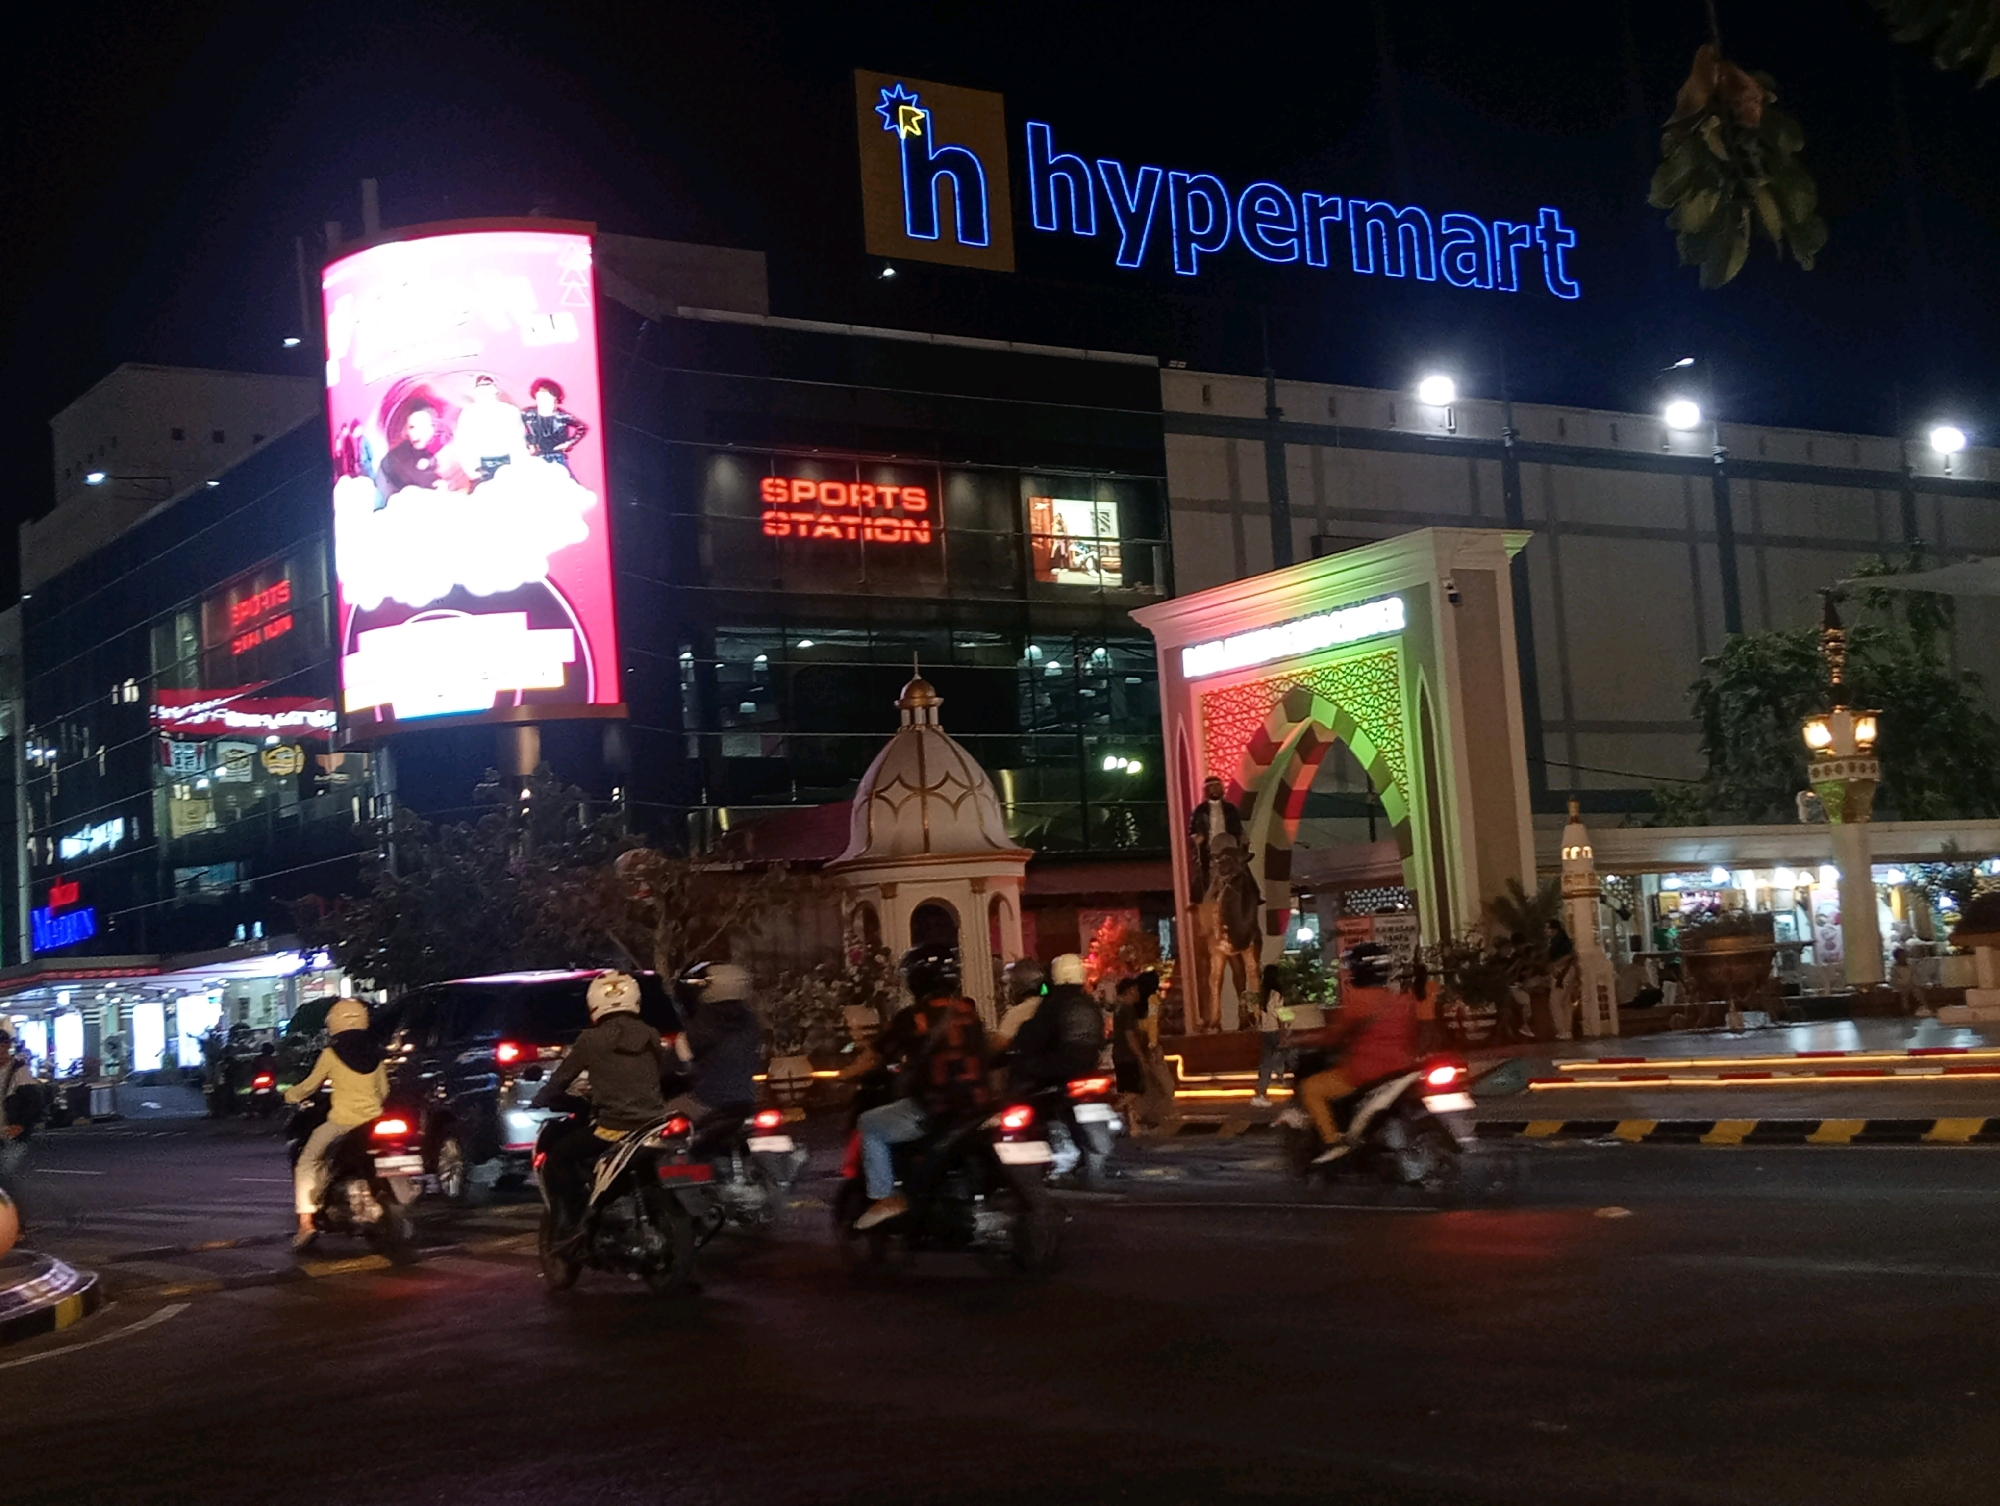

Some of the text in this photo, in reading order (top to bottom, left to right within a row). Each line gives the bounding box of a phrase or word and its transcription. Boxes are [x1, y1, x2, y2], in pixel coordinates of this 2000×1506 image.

[1025, 120, 1581, 300] hypermart
[760, 476, 928, 513] SPORTS
[762, 510, 932, 545] STATION
